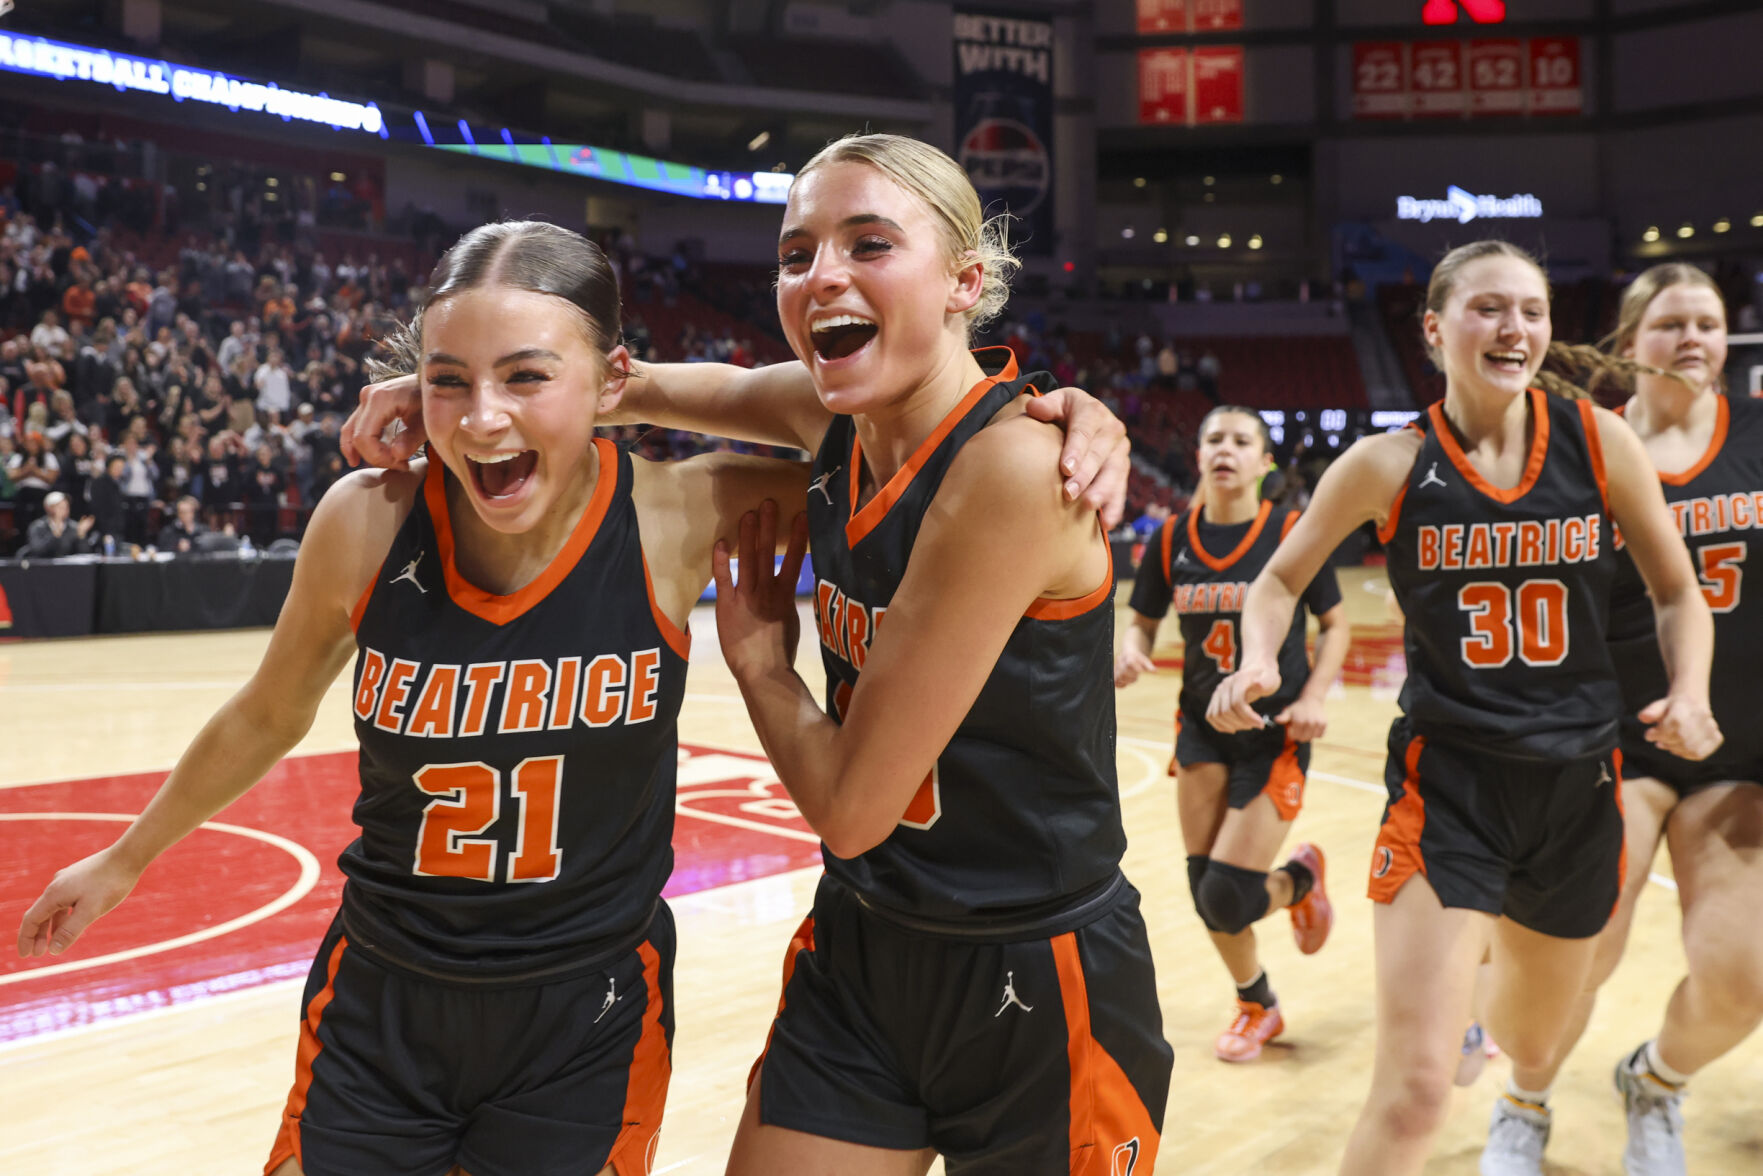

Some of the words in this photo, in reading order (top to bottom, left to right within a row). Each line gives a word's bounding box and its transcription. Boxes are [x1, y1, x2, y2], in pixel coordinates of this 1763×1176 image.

[957, 43, 1048, 84] WITH
[1356, 61, 1400, 90] 22
[1534, 56, 1573, 85] 10
[1418, 514, 1600, 570] BEATRICE
[1202, 619, 1237, 673] 4
[1458, 579, 1568, 669] 30
[354, 647, 660, 738] BEATRICE
[412, 755, 565, 883] 21
